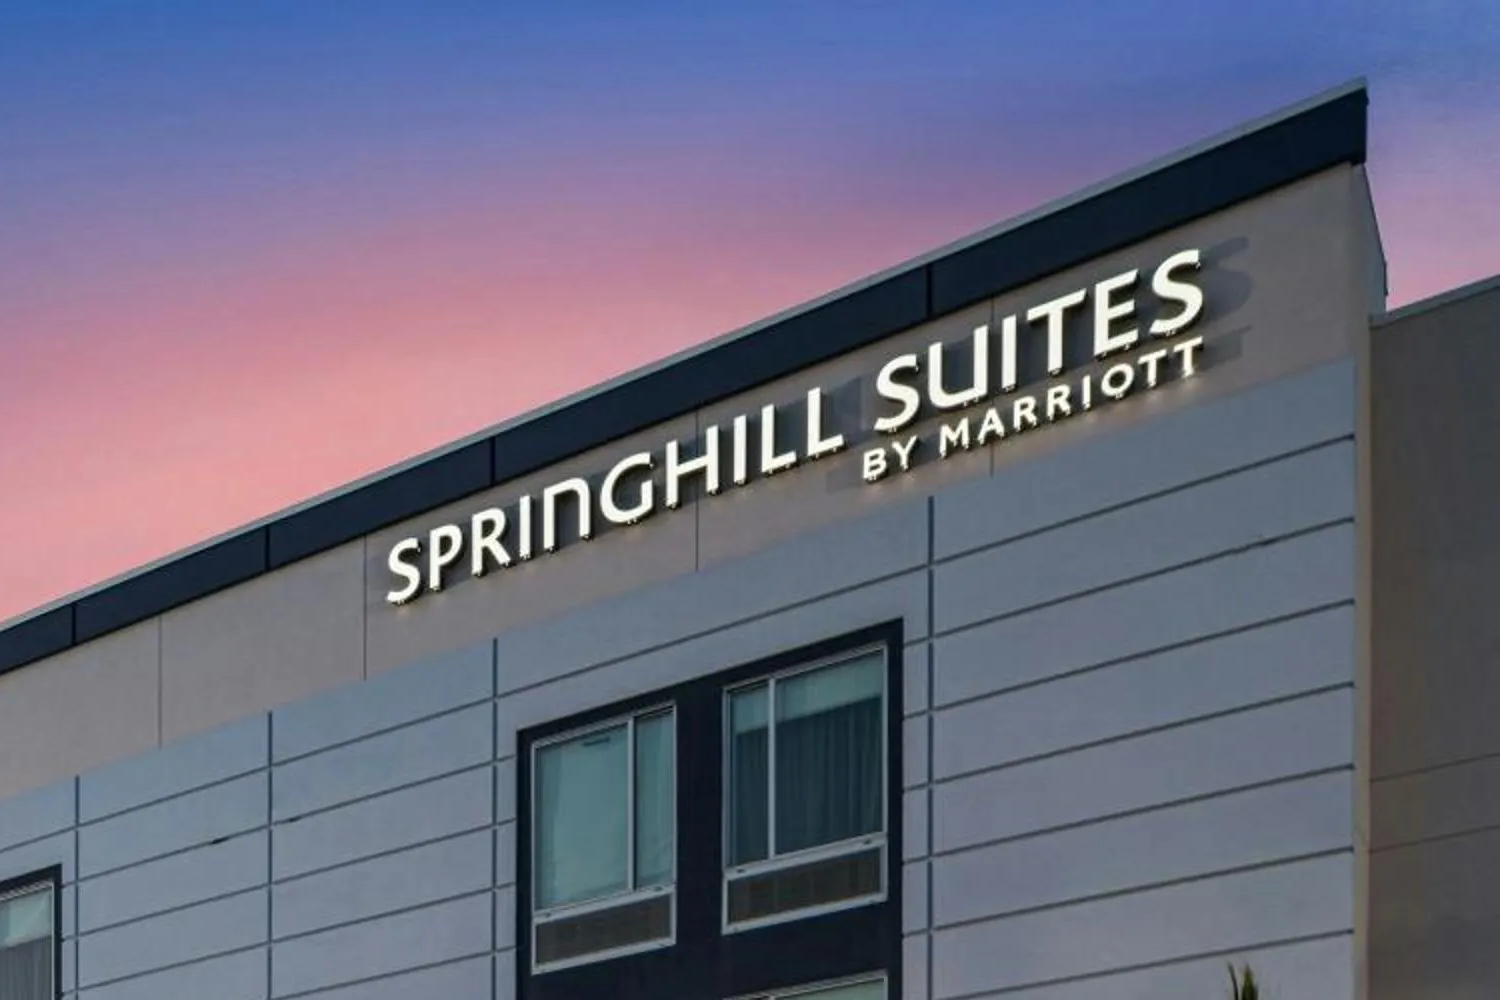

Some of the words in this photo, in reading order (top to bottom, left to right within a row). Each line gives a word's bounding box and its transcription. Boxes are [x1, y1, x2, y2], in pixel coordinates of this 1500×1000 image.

[387, 386, 844, 605] SPRINGHILL
[873, 249, 1204, 433] SUITES
[863, 435, 918, 481] BY
[938, 336, 1203, 459] MARRIOTT
